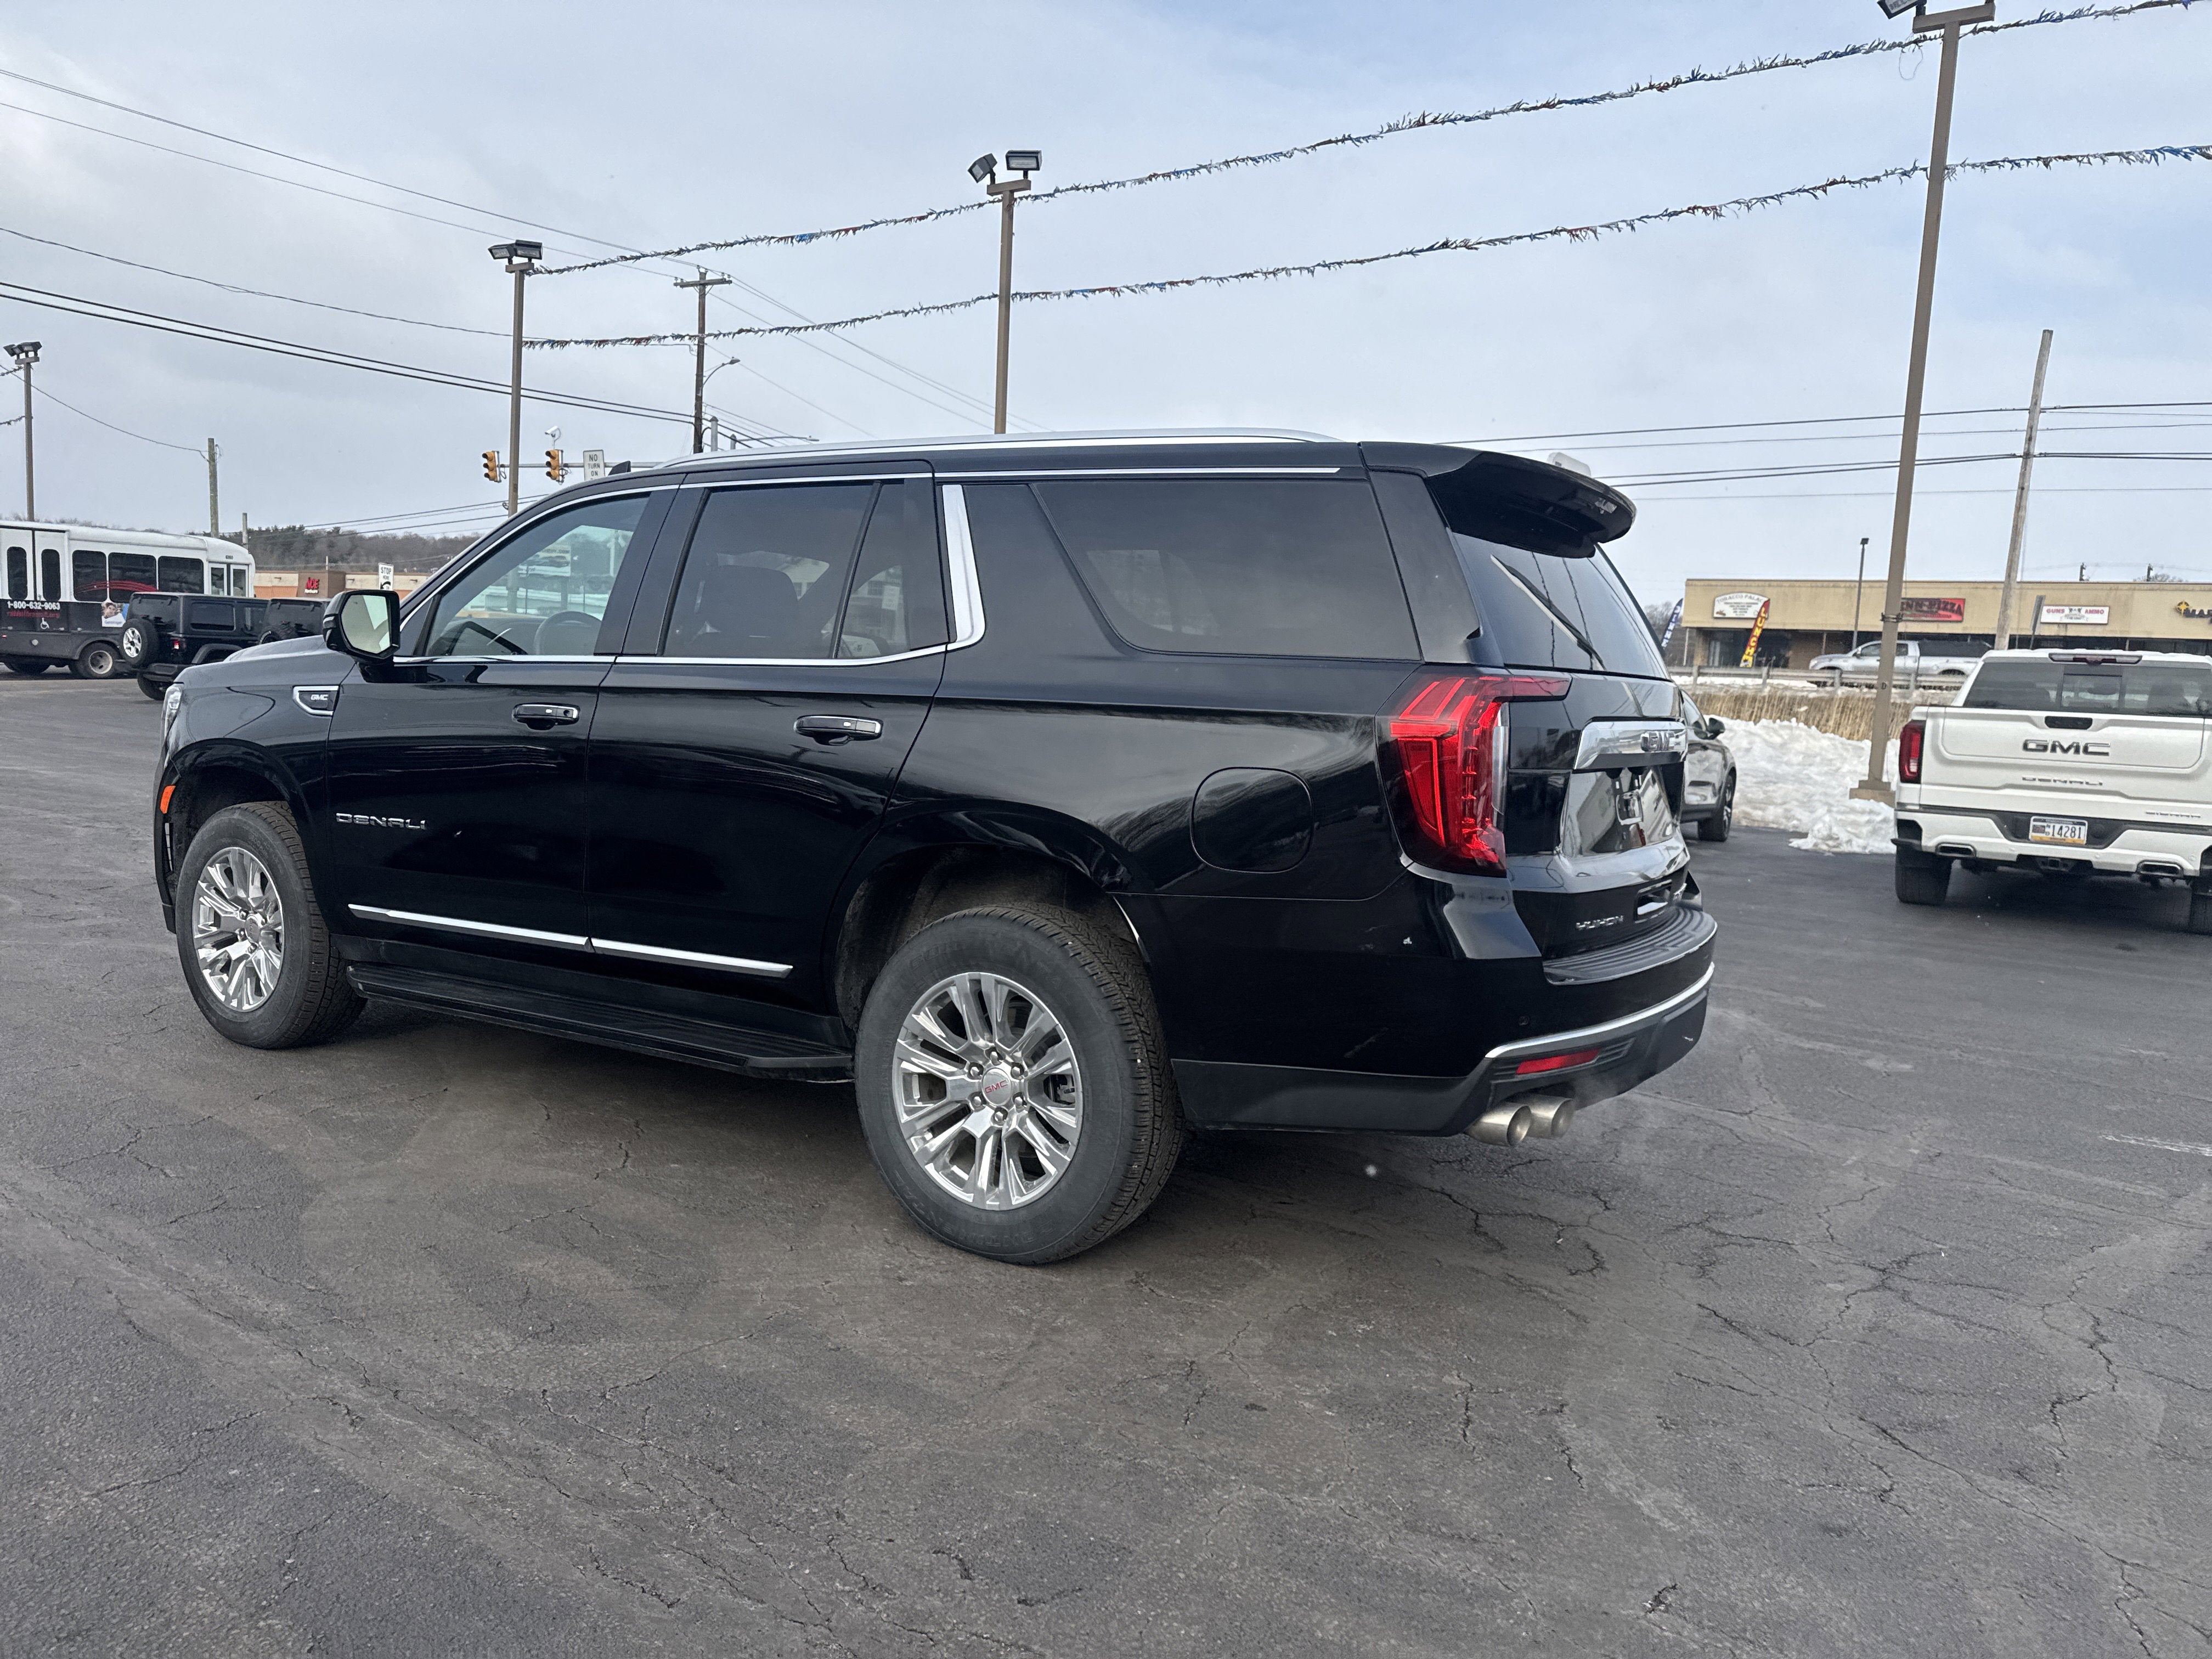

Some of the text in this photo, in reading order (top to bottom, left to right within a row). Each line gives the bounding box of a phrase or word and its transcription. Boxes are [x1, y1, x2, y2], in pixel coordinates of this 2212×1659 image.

[306, 577, 320, 589] ACE
[7, 600, 60, 611] 1-800-632-9063
[1717, 595, 1763, 603] TOBACCO PALAC
[1745, 606, 1766, 656] LUNCH
[2022, 739, 2111, 757] GMC
[2022, 776, 2103, 786] DENALI
[336, 812, 426, 830] DENALI
[2052, 824, 2082, 839] 14281
[1576, 915, 1624, 931] YUKON
[984, 1079, 1009, 1094] GMC
